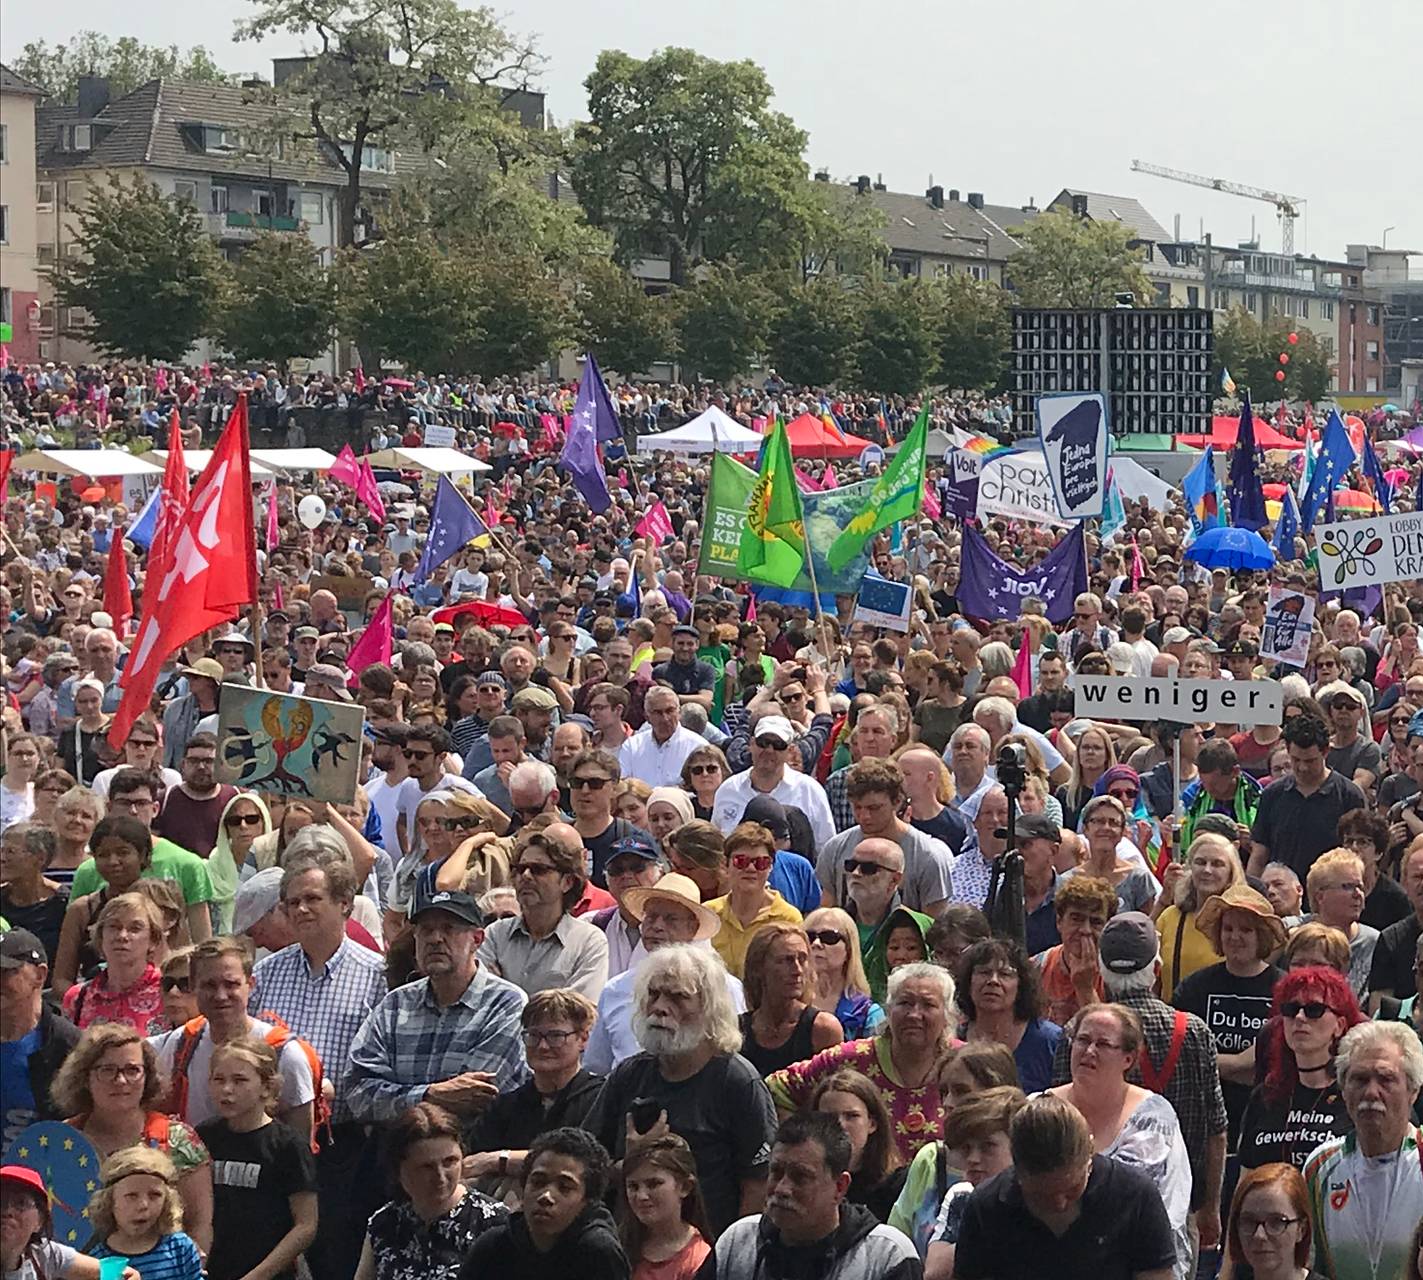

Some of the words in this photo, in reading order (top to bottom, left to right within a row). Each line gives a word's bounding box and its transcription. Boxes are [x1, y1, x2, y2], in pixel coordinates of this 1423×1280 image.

[956, 454, 977, 475] Volt
[1000, 462, 1051, 488] pax
[981, 480, 1056, 513] christi
[715, 511, 736, 527] ES
[1389, 519, 1421, 534] LOBBY
[712, 528, 743, 546] KEI
[710, 544, 739, 561] PLA
[1083, 682, 1275, 713] weniger.
[1213, 1011, 1236, 1028] Du
[1287, 1110, 1335, 1124] Meine
[1256, 1128, 1346, 1146] Gewerksch
